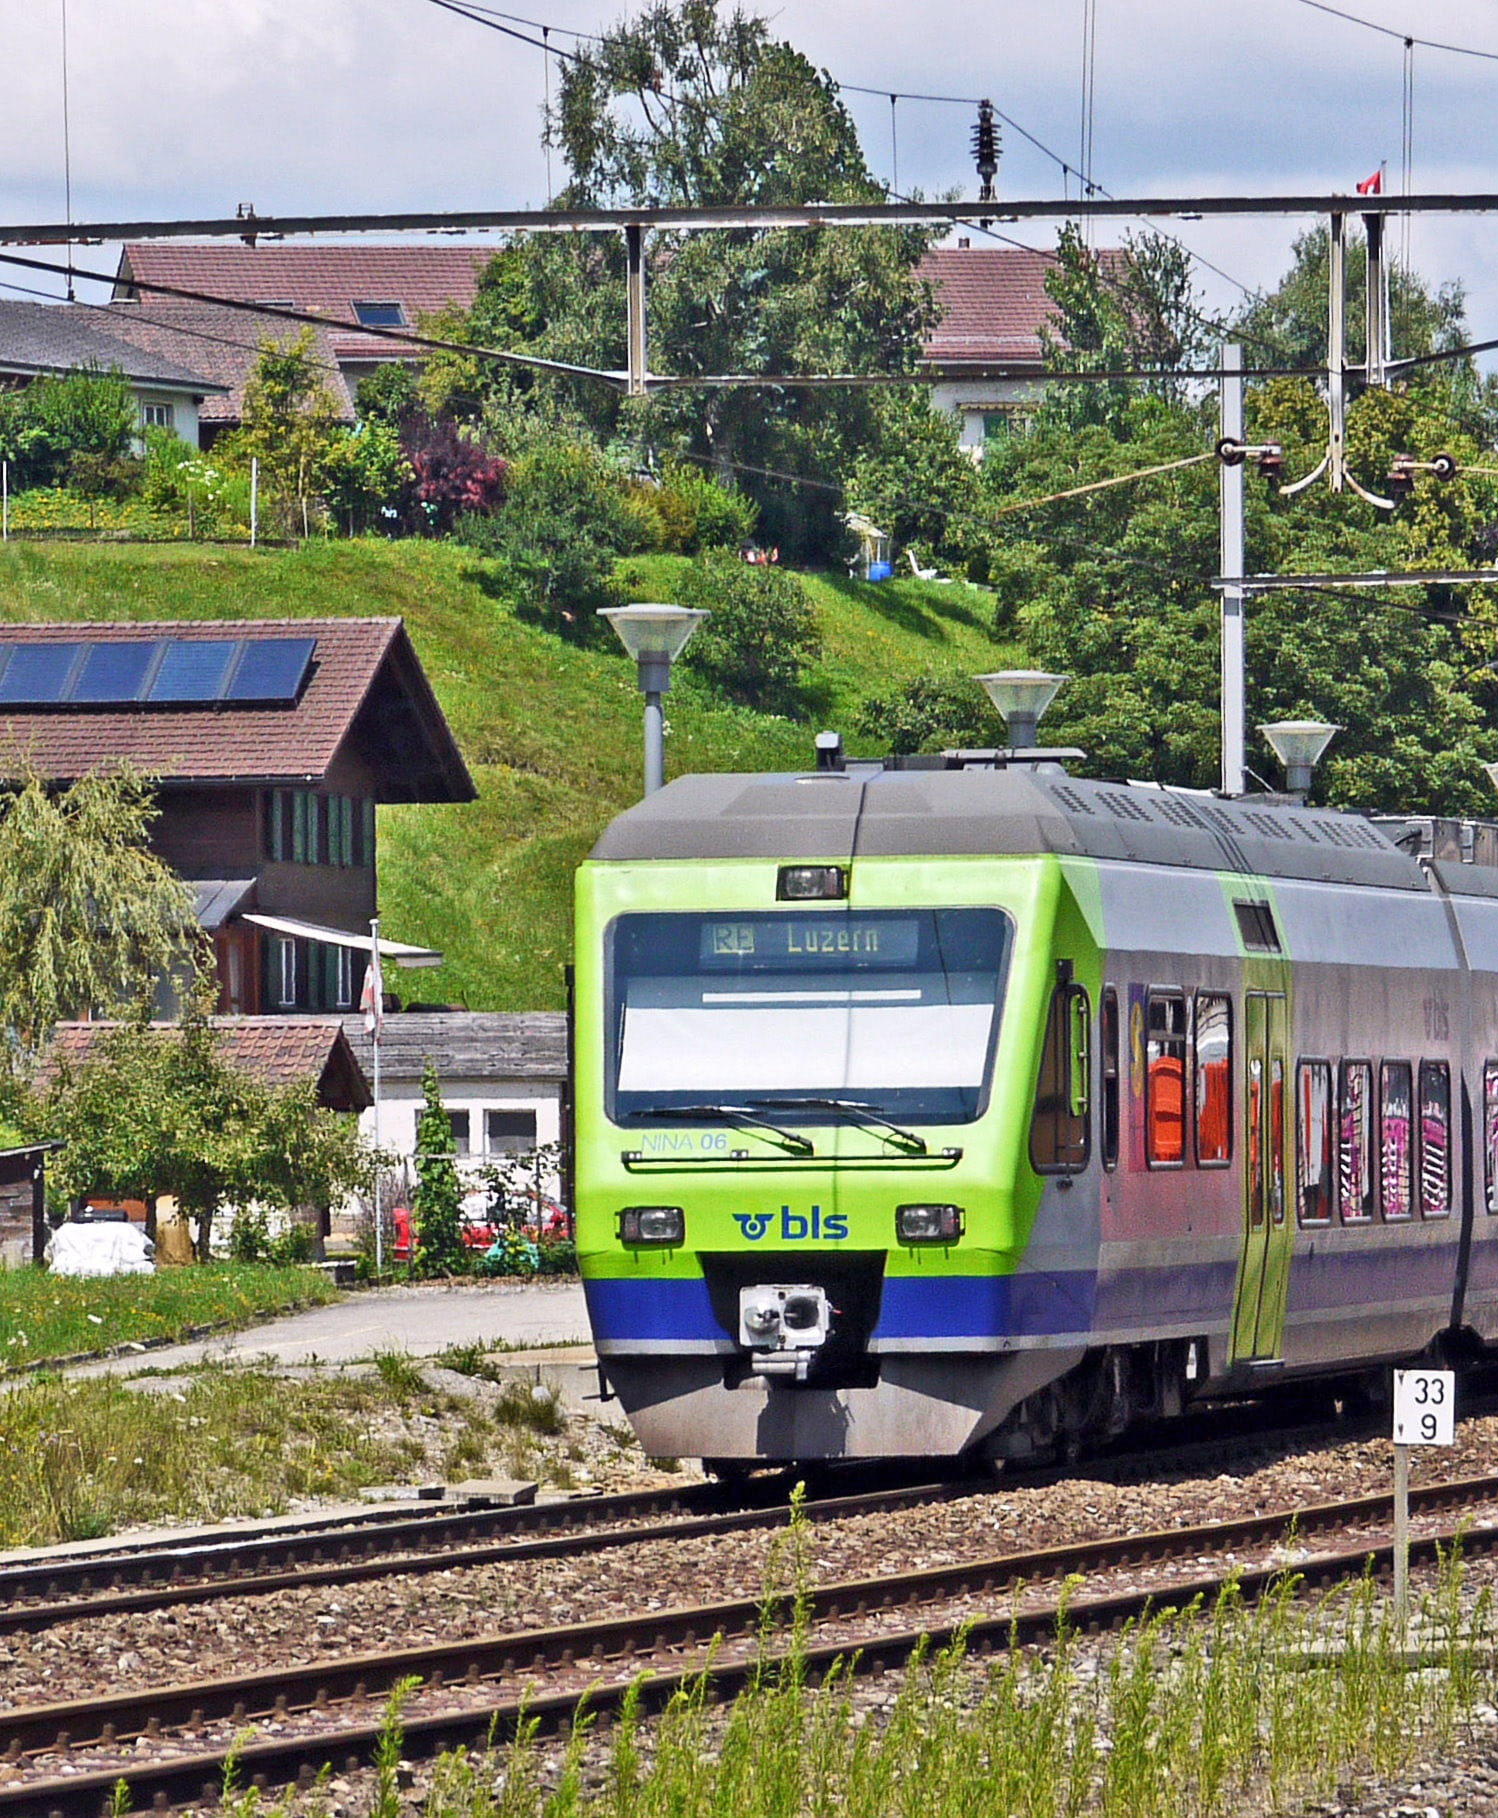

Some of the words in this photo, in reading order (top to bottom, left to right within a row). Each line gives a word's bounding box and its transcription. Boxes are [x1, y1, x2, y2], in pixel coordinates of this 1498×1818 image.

[788, 925, 878, 952] Luzern
[641, 1134, 694, 1151] NINA
[700, 1133, 728, 1150] 06
[781, 1205, 849, 1240] bls
[1415, 1377, 1445, 1405] 33
[1421, 1413, 1437, 1441] 9
